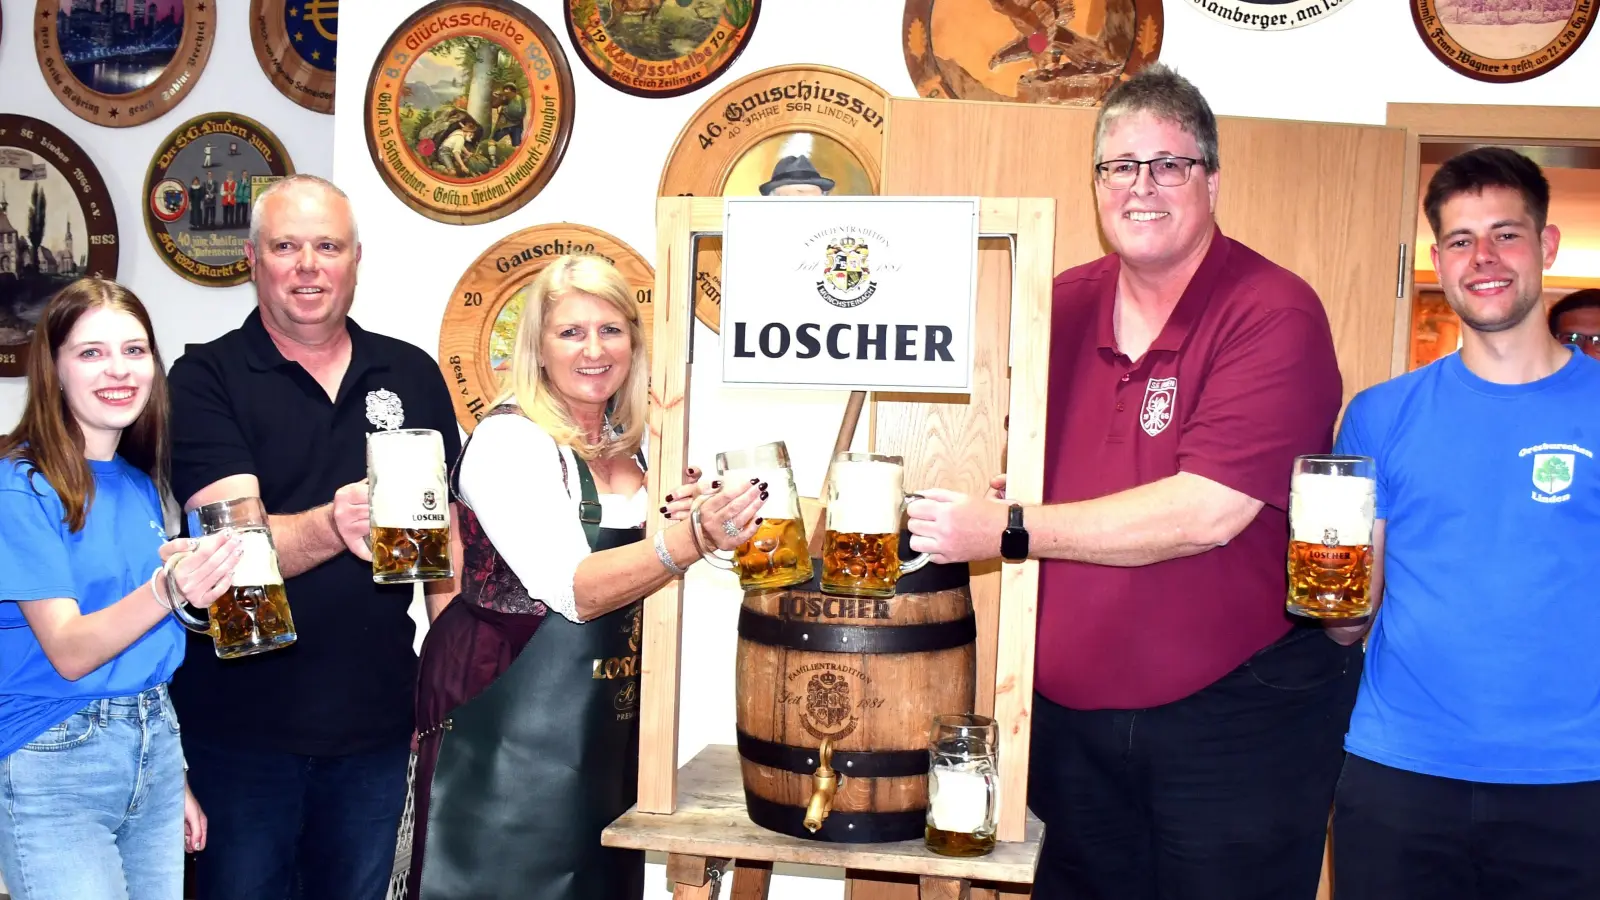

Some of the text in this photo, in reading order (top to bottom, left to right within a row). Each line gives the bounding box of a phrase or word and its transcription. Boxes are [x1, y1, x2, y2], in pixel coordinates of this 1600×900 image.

[1296, 4, 1322, 21] am
[405, 11, 525, 51] Glücksscheibe
[591, 28, 725, 78] 19 Königsscheibe 70
[1430, 27, 1457, 58] Franz
[1456, 50, 1500, 73] Wagner
[1536, 54, 1549, 66] am
[657, 70, 702, 88] Zeilinger
[201, 119, 249, 138] Linden
[727, 101, 859, 140] 40 JAHRE SGR LINDEN
[20, 128, 35, 140] SG
[697, 120, 727, 151] 46.
[463, 291, 483, 307] 20
[636, 288, 652, 304] 01
[732, 321, 956, 363] LOSCHER
[412, 513, 446, 522] LOSCHER
[1310, 550, 1351, 560] LOSCHER
[788, 662, 873, 685] FAMILIENTRADITION
[856, 697, 886, 709] 1881
